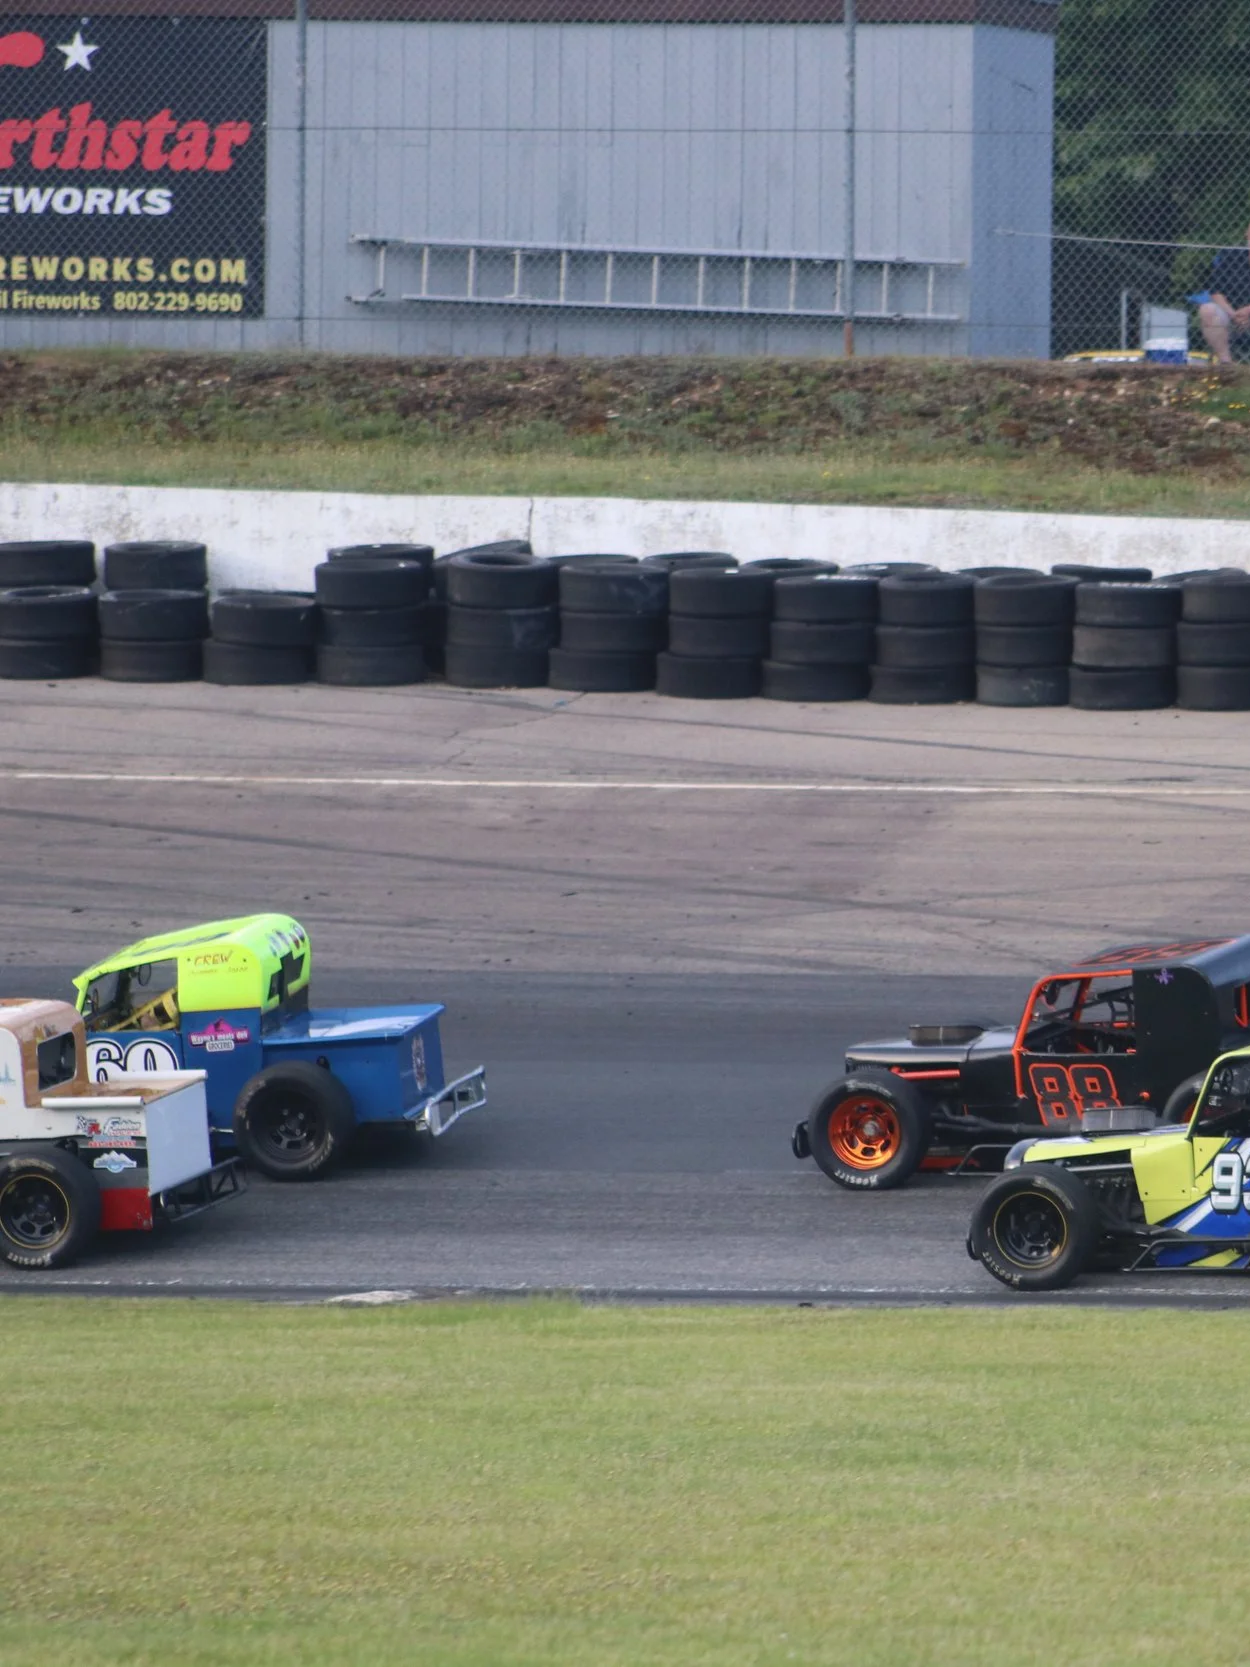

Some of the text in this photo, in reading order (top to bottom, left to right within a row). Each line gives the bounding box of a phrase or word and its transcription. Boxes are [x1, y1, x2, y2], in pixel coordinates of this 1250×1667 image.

[0, 101, 251, 172] rthstar
[12, 289, 101, 310] Fireworks
[113, 291, 243, 312] 802-229-9690
[194, 949, 233, 967] CREW
[1029, 1063, 1122, 1127] 88
